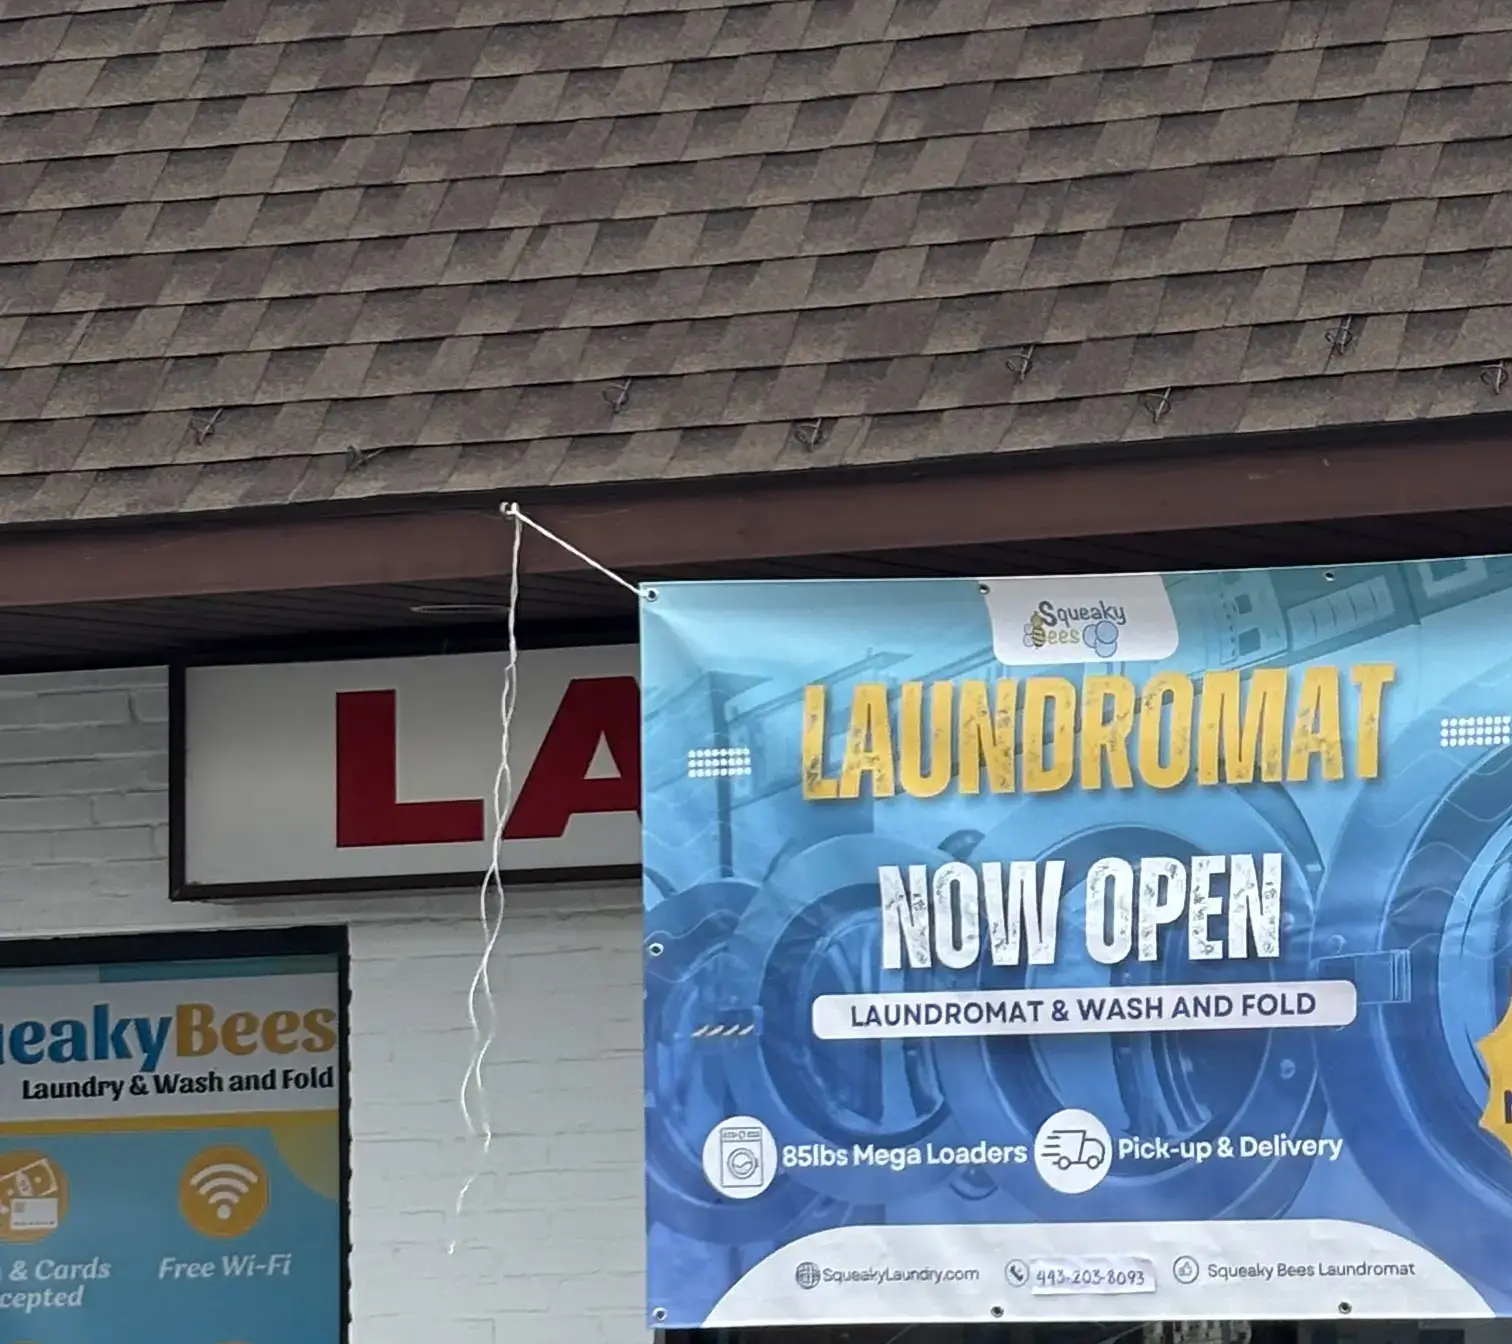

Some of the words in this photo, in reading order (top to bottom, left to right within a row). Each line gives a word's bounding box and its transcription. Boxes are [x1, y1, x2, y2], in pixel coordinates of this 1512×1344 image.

[1038, 600, 1127, 629] Squeaky
[802, 665, 1395, 800] LAUNDROMAT
[878, 860, 1065, 970] NOW
[1085, 853, 1282, 964] OPEN
[851, 999, 1044, 1027] LAUNDROMAT
[1051, 1000, 1069, 1021] &
[1077, 997, 1163, 1021] WASH
[1171, 995, 1233, 1018] AND
[1241, 993, 1316, 1017] FOLD
[22, 1075, 124, 1102] Laundry
[129, 1075, 149, 1095] &
[153, 1071, 224, 1094] Wash
[229, 1068, 276, 1092] and
[282, 1066, 334, 1090] Fold
[782, 1143, 849, 1168] 85lbs
[852, 1143, 922, 1171] Mega
[926, 1141, 1028, 1165] Loaders
[1118, 1136, 1213, 1164] Pick-up
[1217, 1136, 1235, 1158] &
[1240, 1132, 1344, 1161] Delivery
[8, 1259, 28, 1281] &
[34, 1256, 112, 1280] Cards
[158, 1256, 216, 1280] Free
[222, 1253, 293, 1277] Wi-Fi
[822, 1265, 980, 1286] SqueakyLaundry.com
[1207, 1262, 1274, 1282] Squeaky
[1277, 1262, 1315, 1278] Bees
[1318, 1260, 1416, 1278] Laundromat
